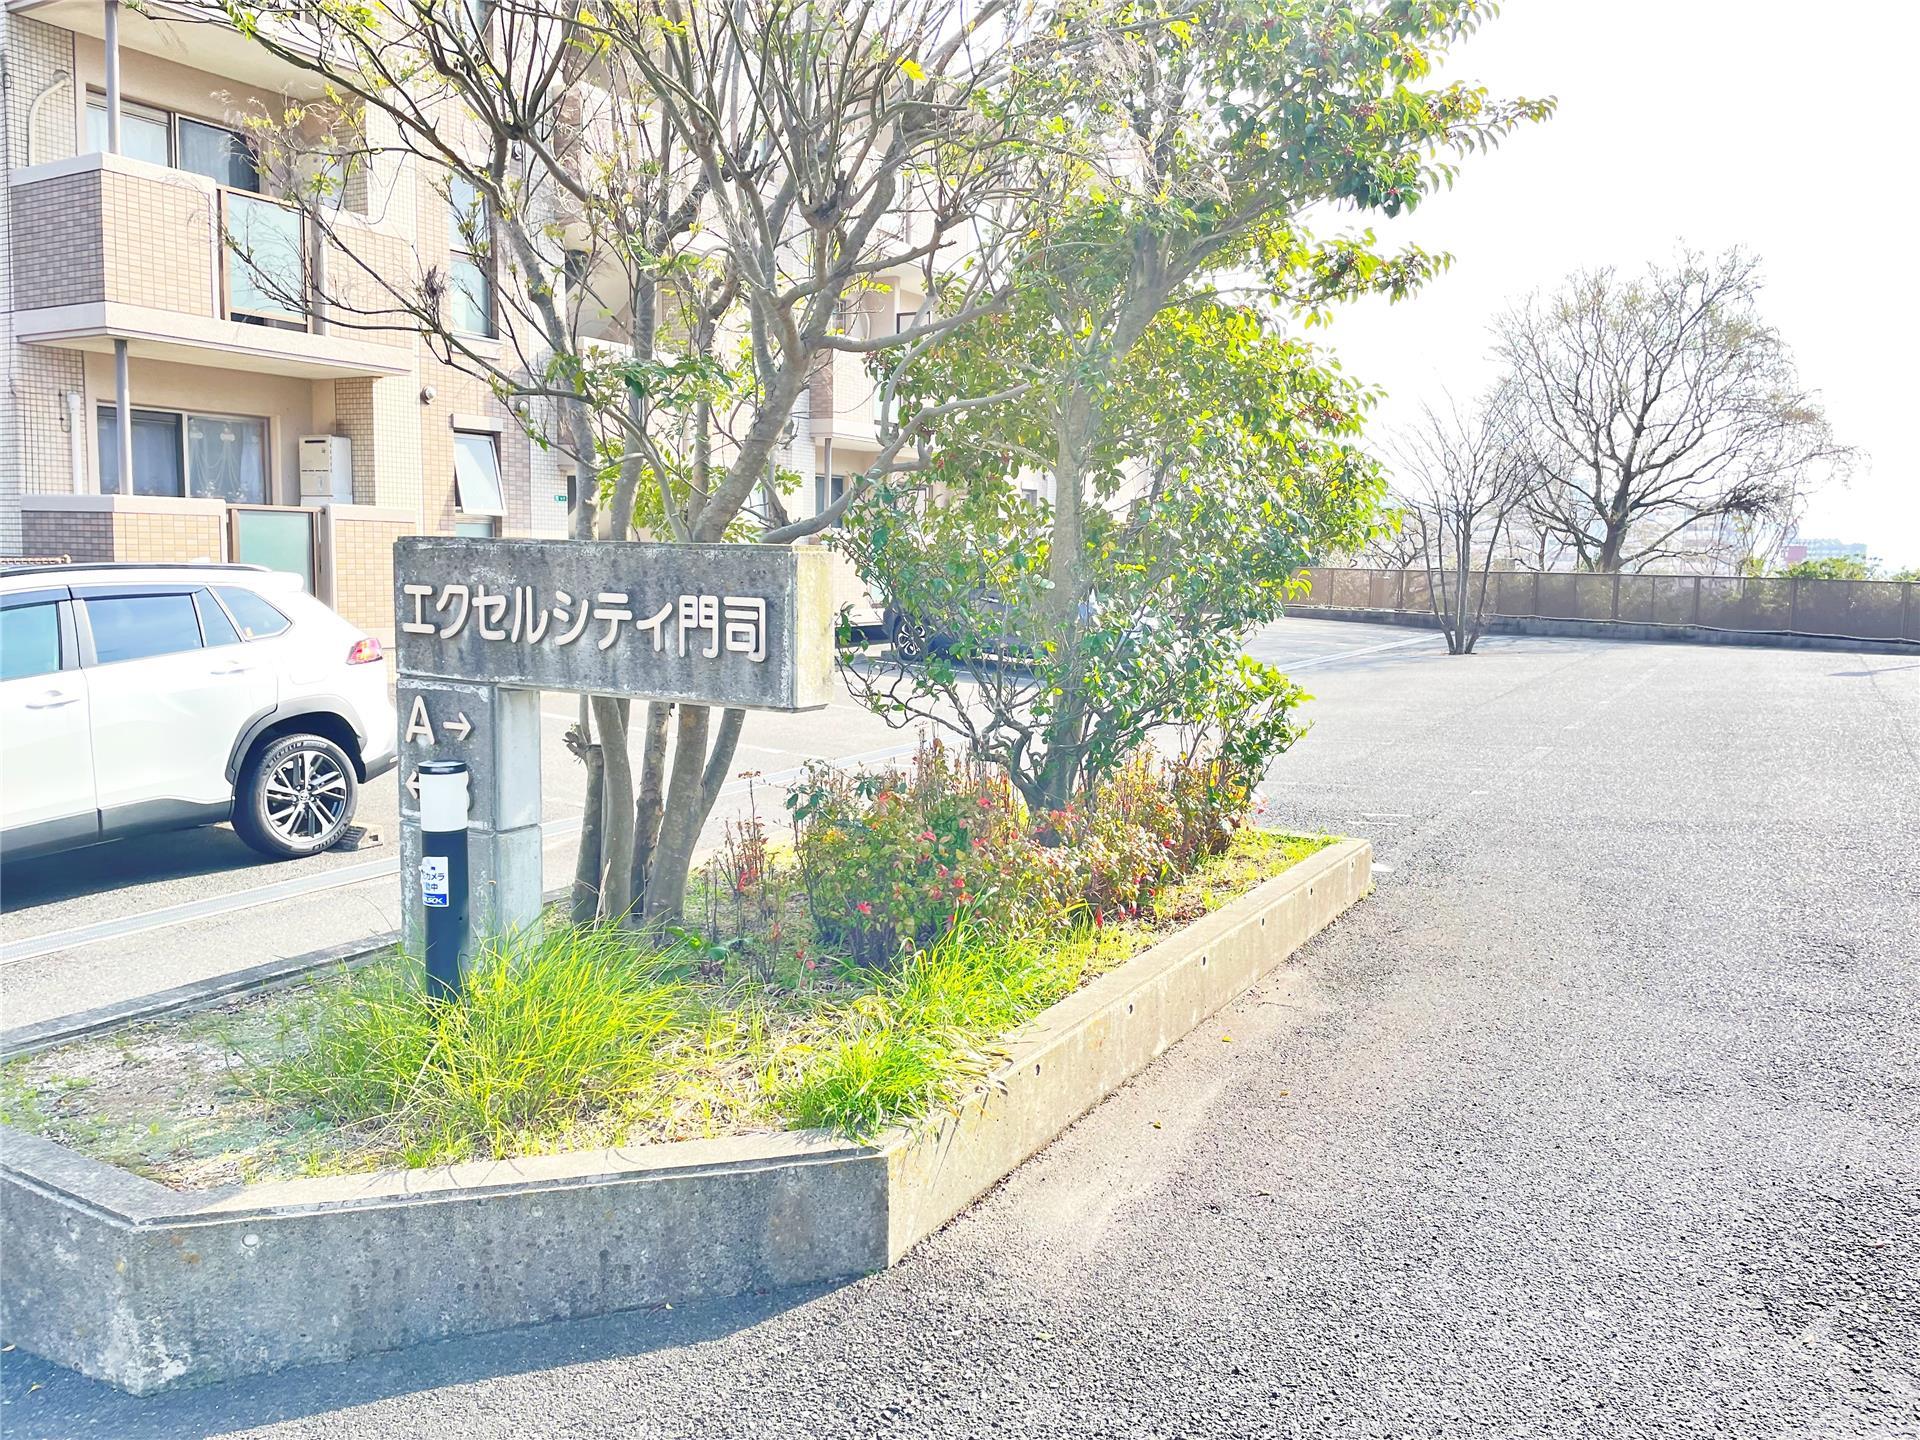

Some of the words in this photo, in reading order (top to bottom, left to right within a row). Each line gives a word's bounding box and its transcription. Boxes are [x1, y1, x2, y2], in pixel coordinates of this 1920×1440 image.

[402, 584, 767, 663] エクセルシティ門司
[405, 694, 434, 745] A
